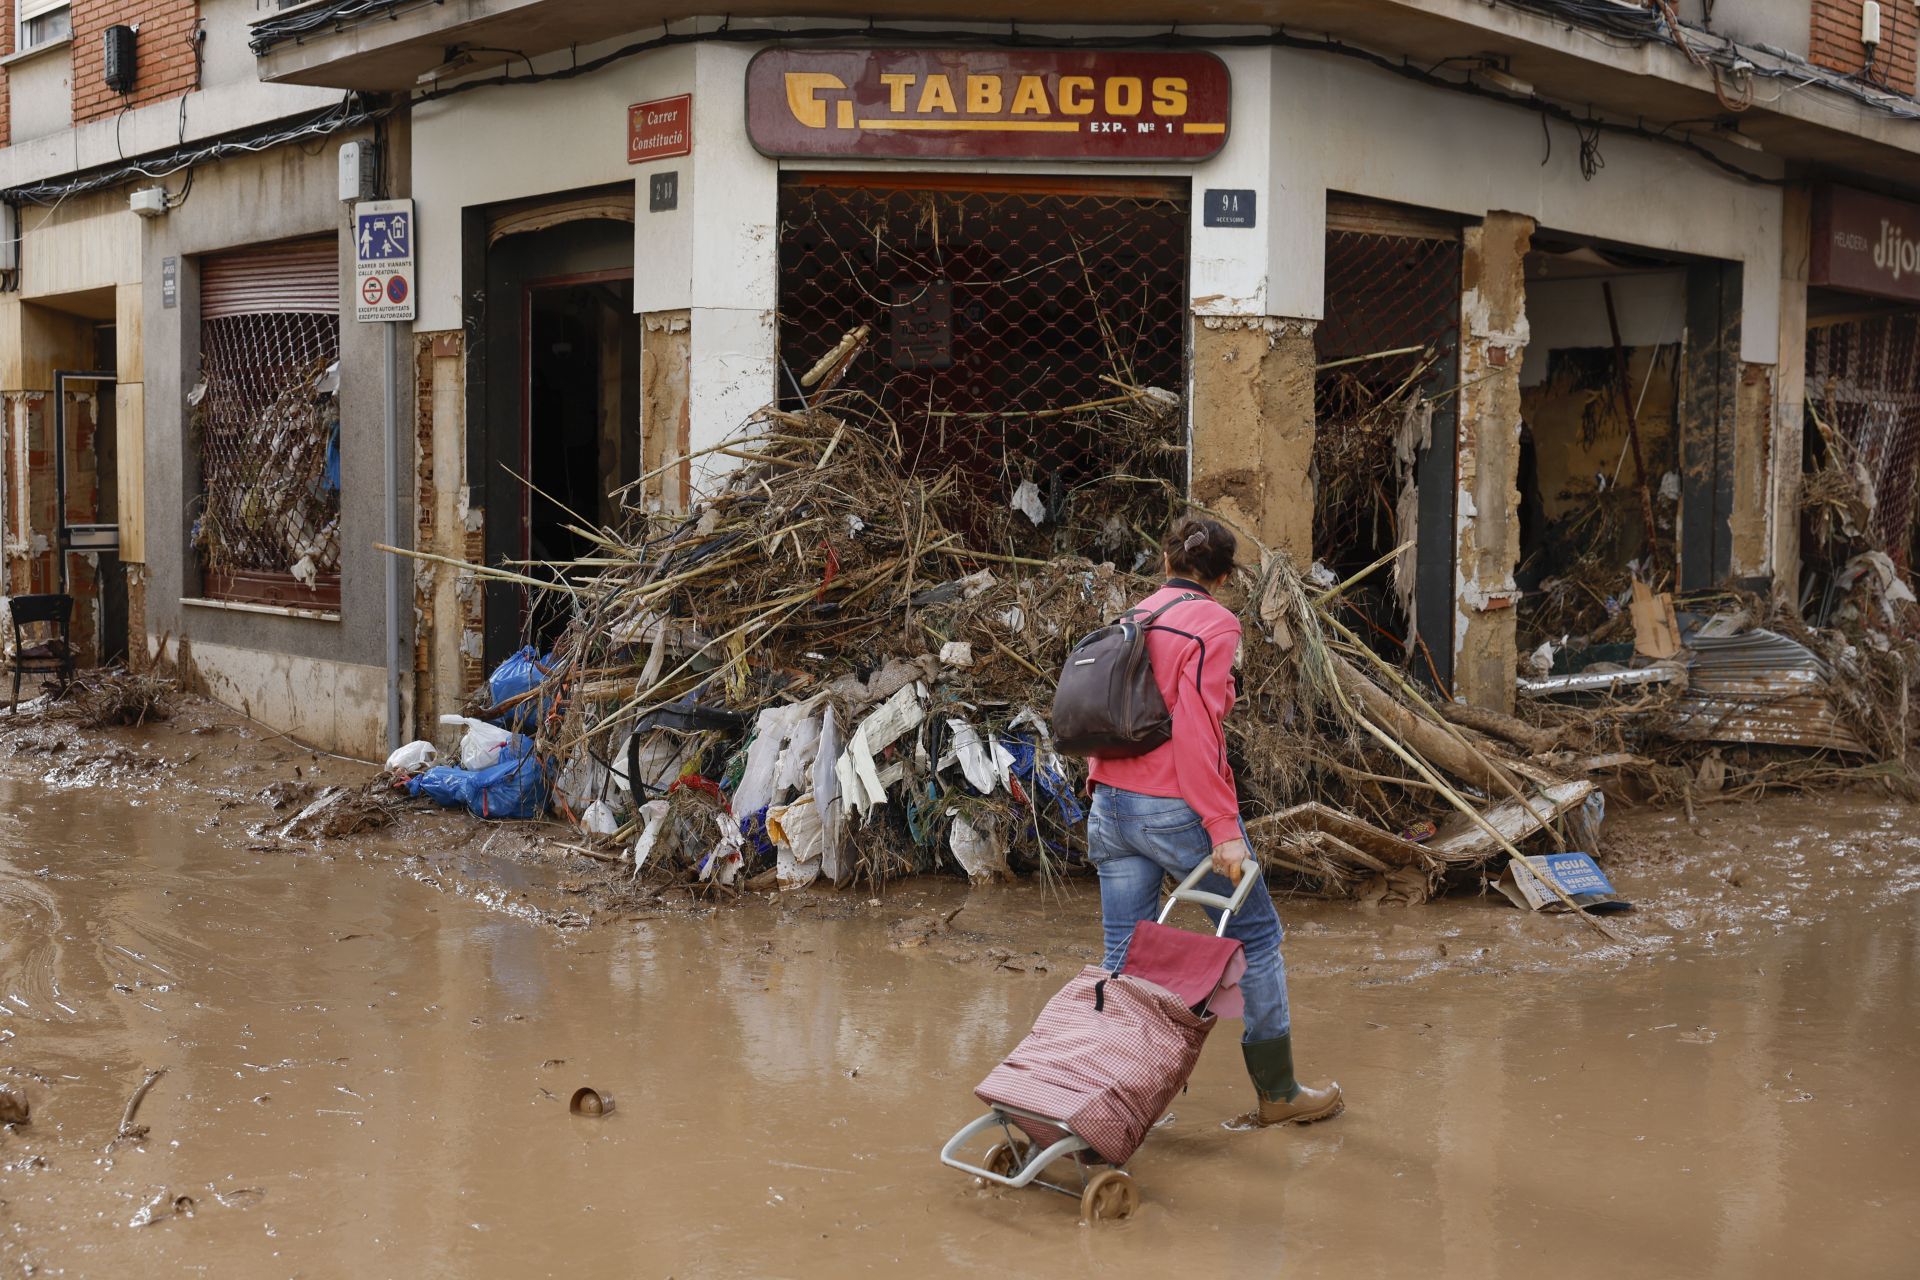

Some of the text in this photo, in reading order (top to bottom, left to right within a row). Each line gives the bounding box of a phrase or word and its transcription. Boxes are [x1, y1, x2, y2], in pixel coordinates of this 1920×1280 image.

[881, 74, 1188, 116] TABACOS
[647, 110, 678, 125] Carrer
[1090, 122, 1127, 133] EXP.
[1165, 123, 1173, 133] 1
[632, 130, 683, 151] Constitució
[1222, 194, 1239, 211] 9 A
[1553, 859, 1589, 870] AGUA
